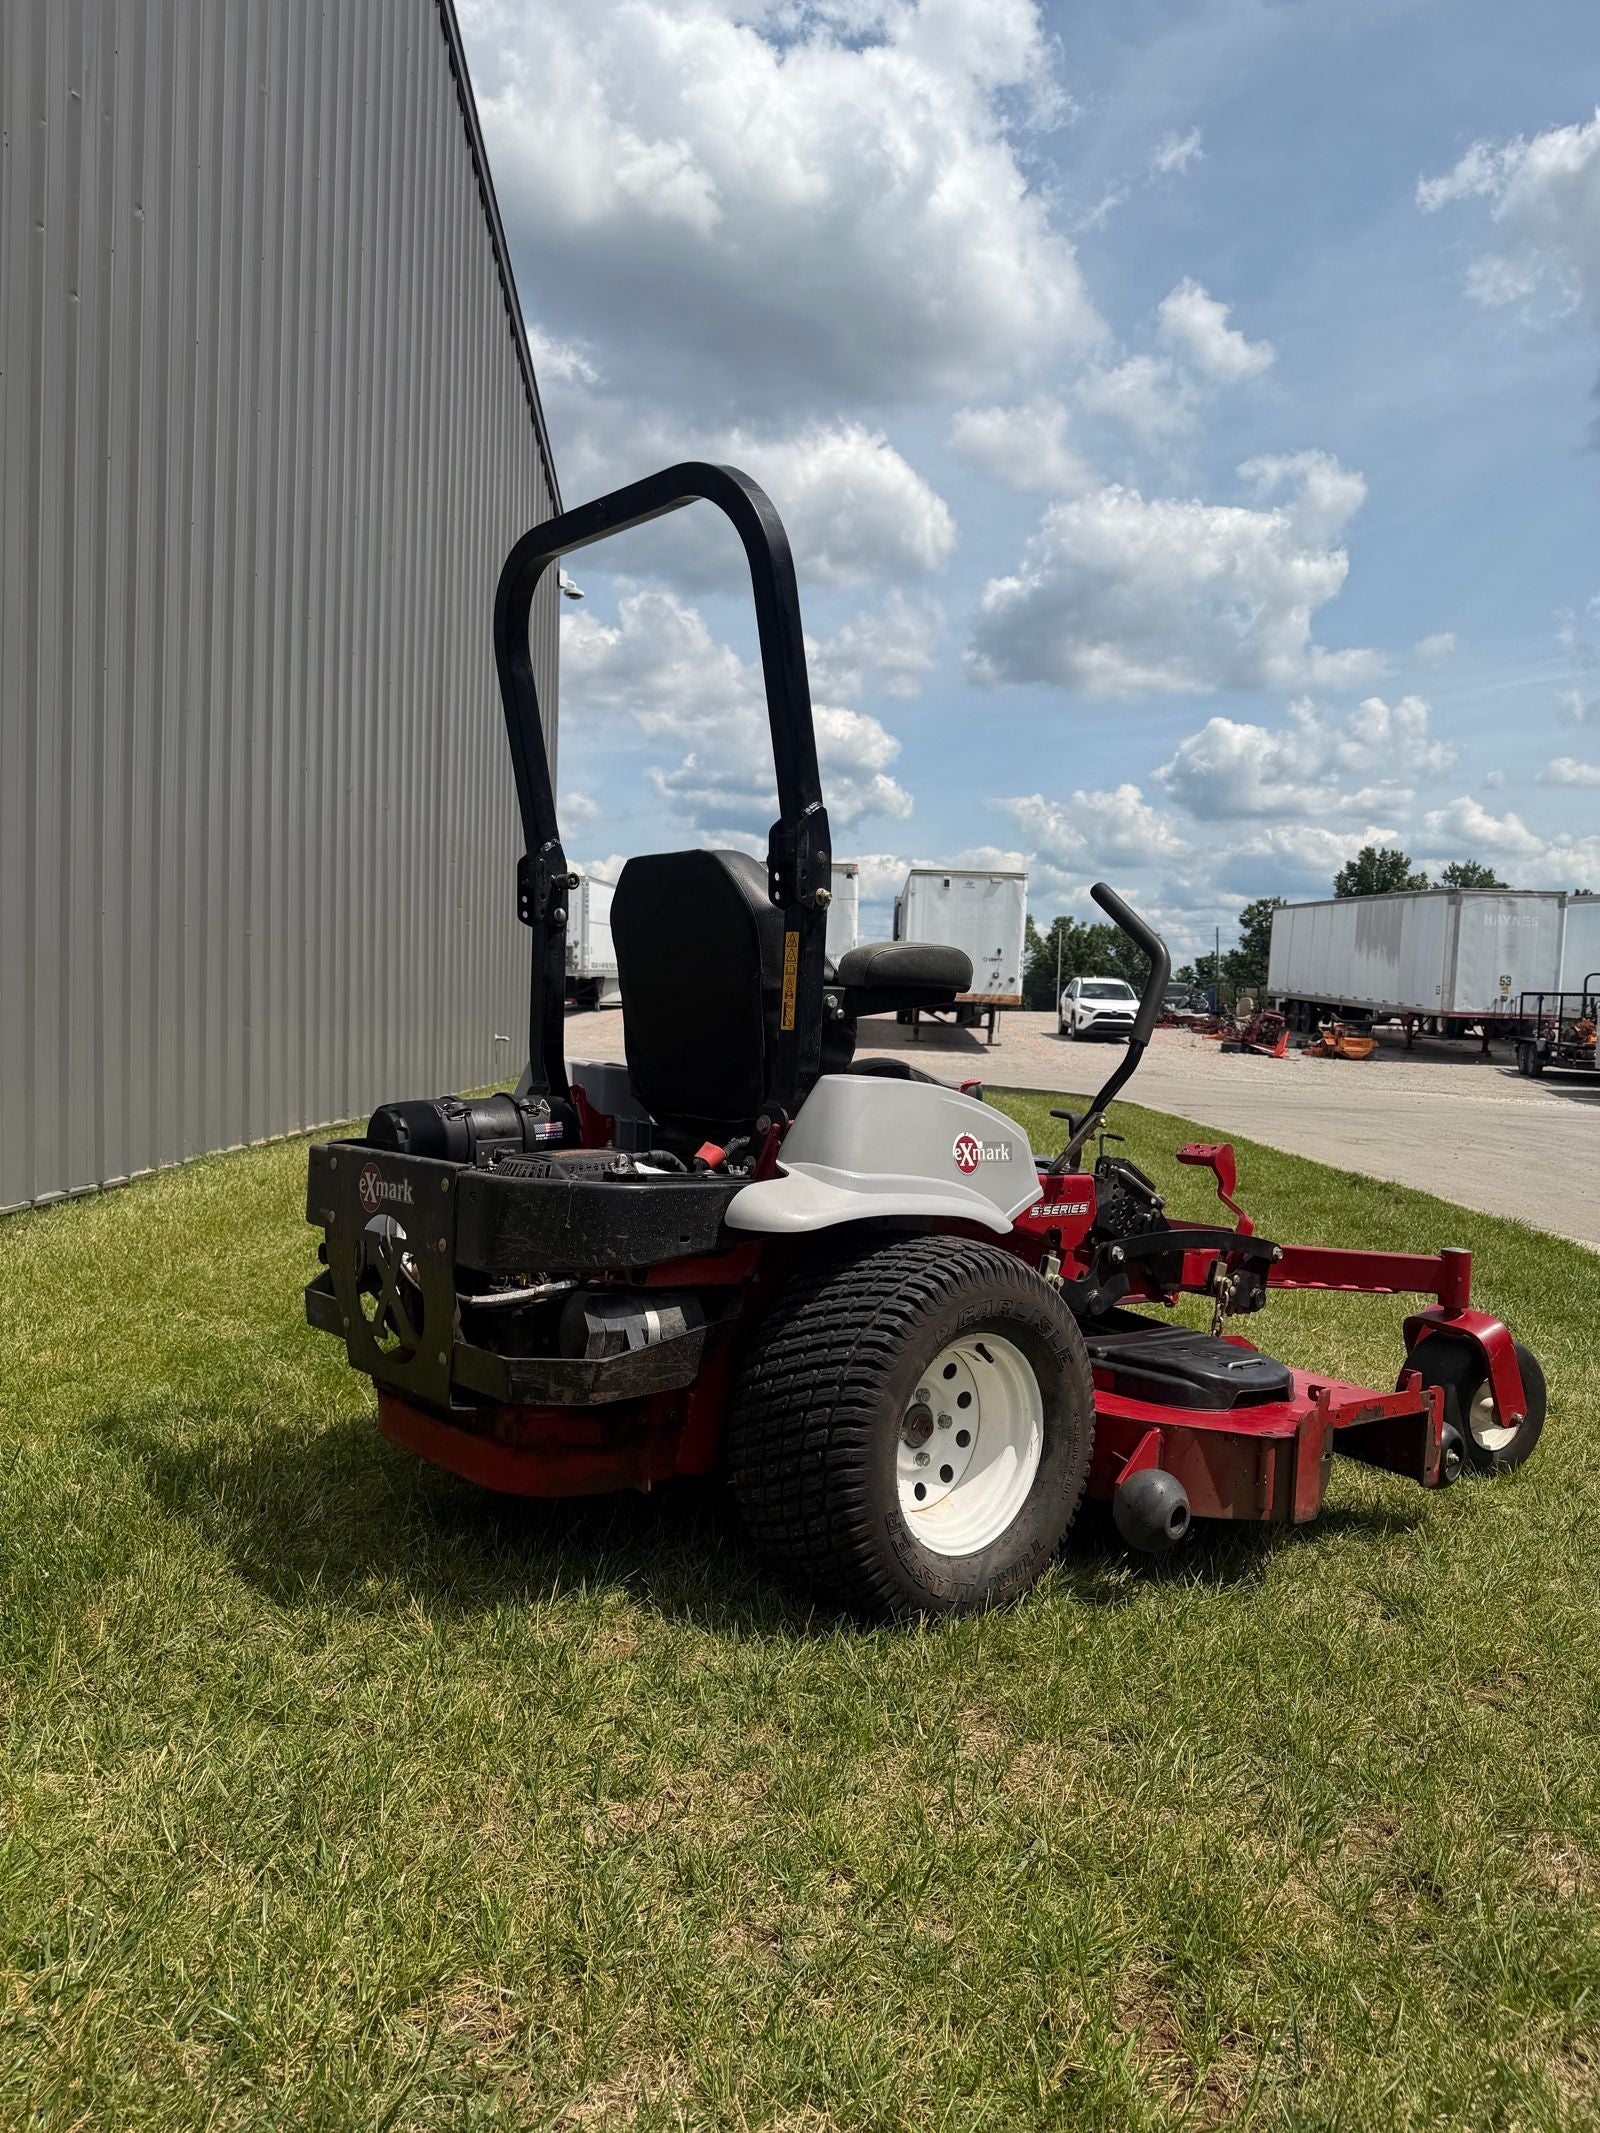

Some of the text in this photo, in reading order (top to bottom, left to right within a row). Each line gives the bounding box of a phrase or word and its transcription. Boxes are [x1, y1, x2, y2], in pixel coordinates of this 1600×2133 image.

[1499, 976, 1512, 986] 53
[955, 1142, 1010, 1167] eXmark
[359, 1172, 415, 1205] eXmark
[1030, 1203, 1089, 1217] S-SERIES
[957, 1299, 1075, 1372] CARLISLE
[885, 1508, 975, 1604] MASTER
